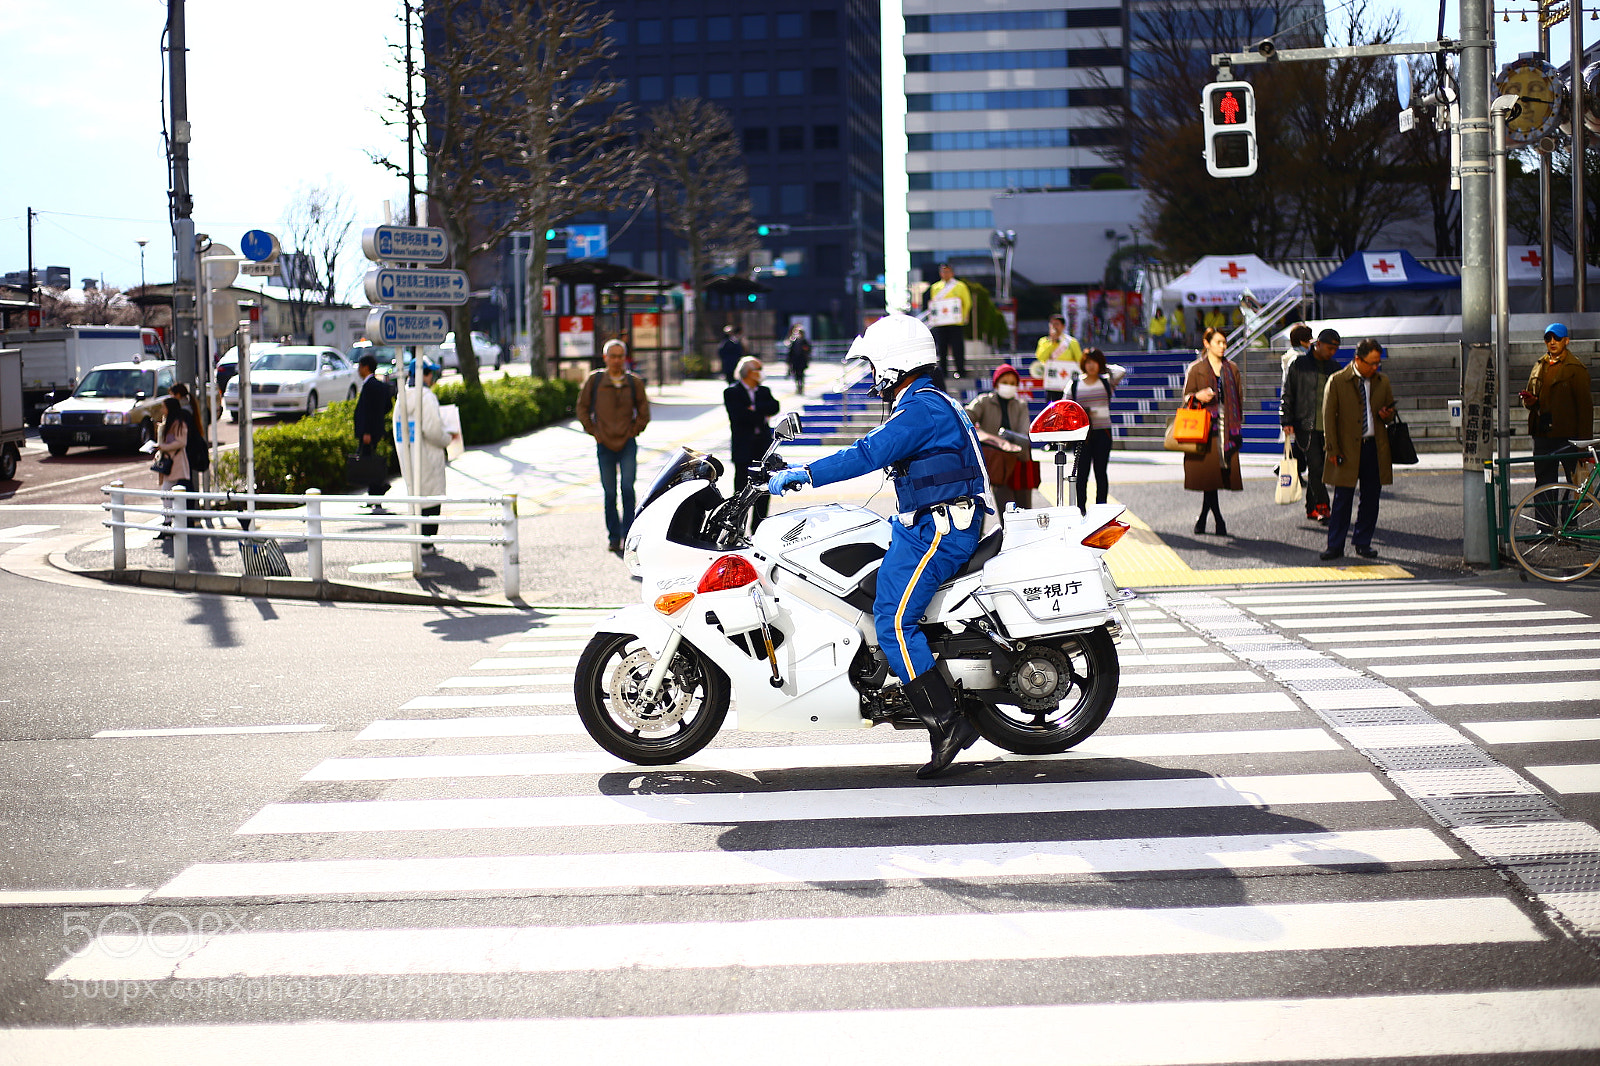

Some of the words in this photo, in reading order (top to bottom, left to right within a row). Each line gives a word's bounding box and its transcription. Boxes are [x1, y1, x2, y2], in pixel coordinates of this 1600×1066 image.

[1182, 418, 1199, 430] T2
[1022, 580, 1083, 601] 警視庁
[1052, 598, 1061, 612] 4
